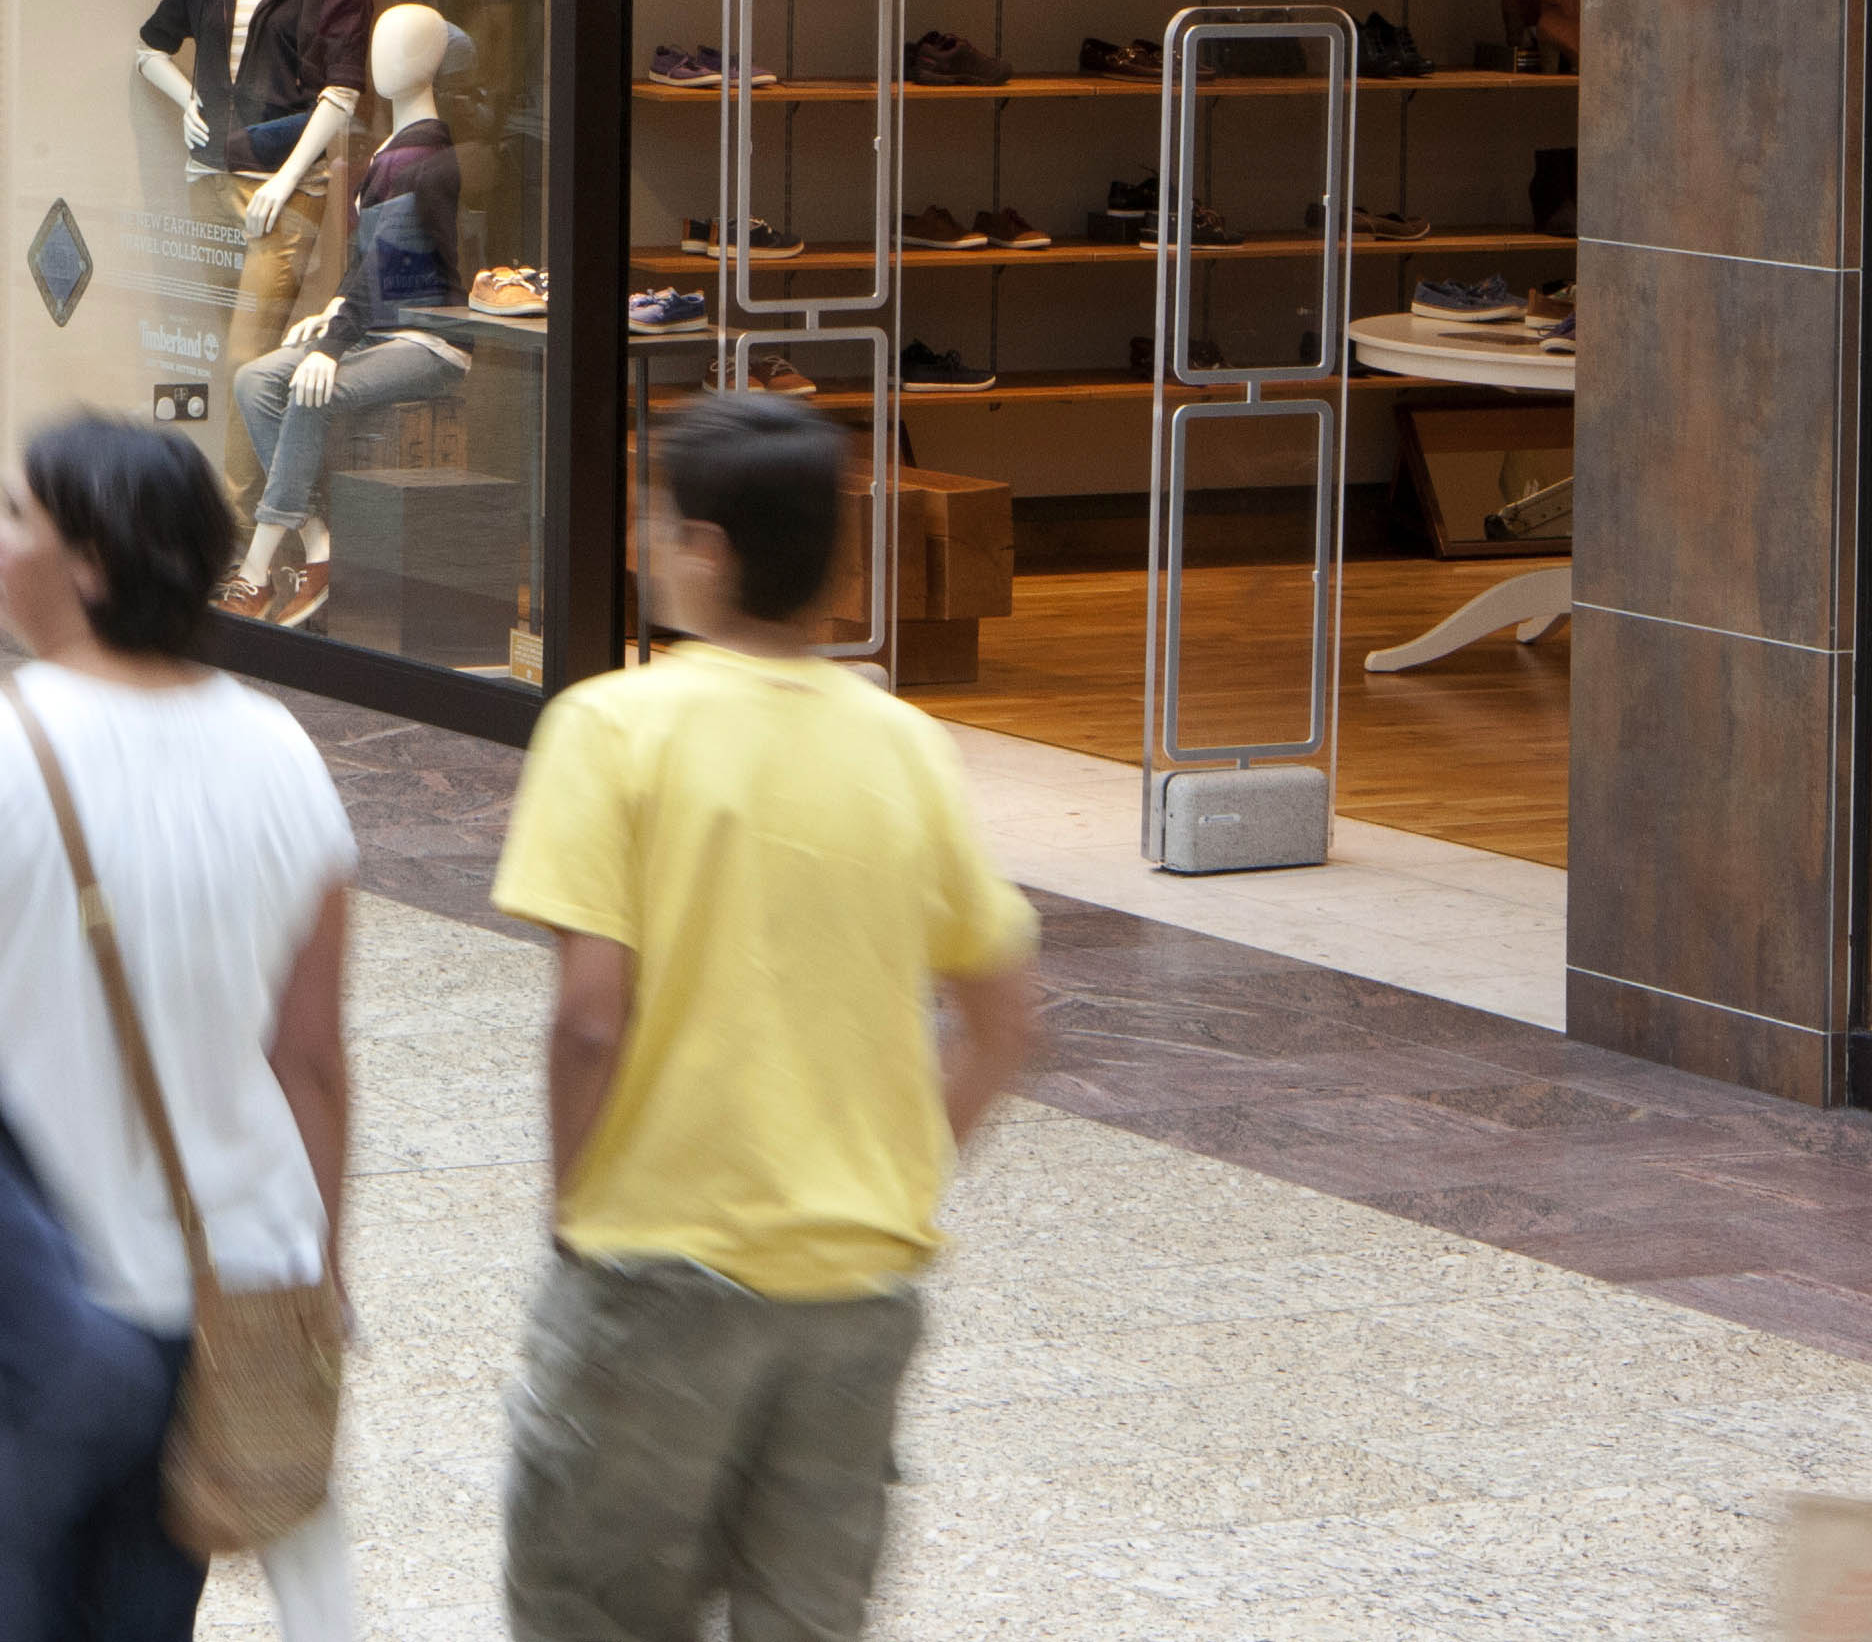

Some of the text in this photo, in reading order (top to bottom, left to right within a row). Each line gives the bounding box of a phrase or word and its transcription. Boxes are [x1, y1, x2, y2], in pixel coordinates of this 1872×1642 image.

[163, 216, 248, 246] EARTHKEEPERS
[161, 239, 233, 268] COLLECTION
[138, 320, 201, 358] Timberland
